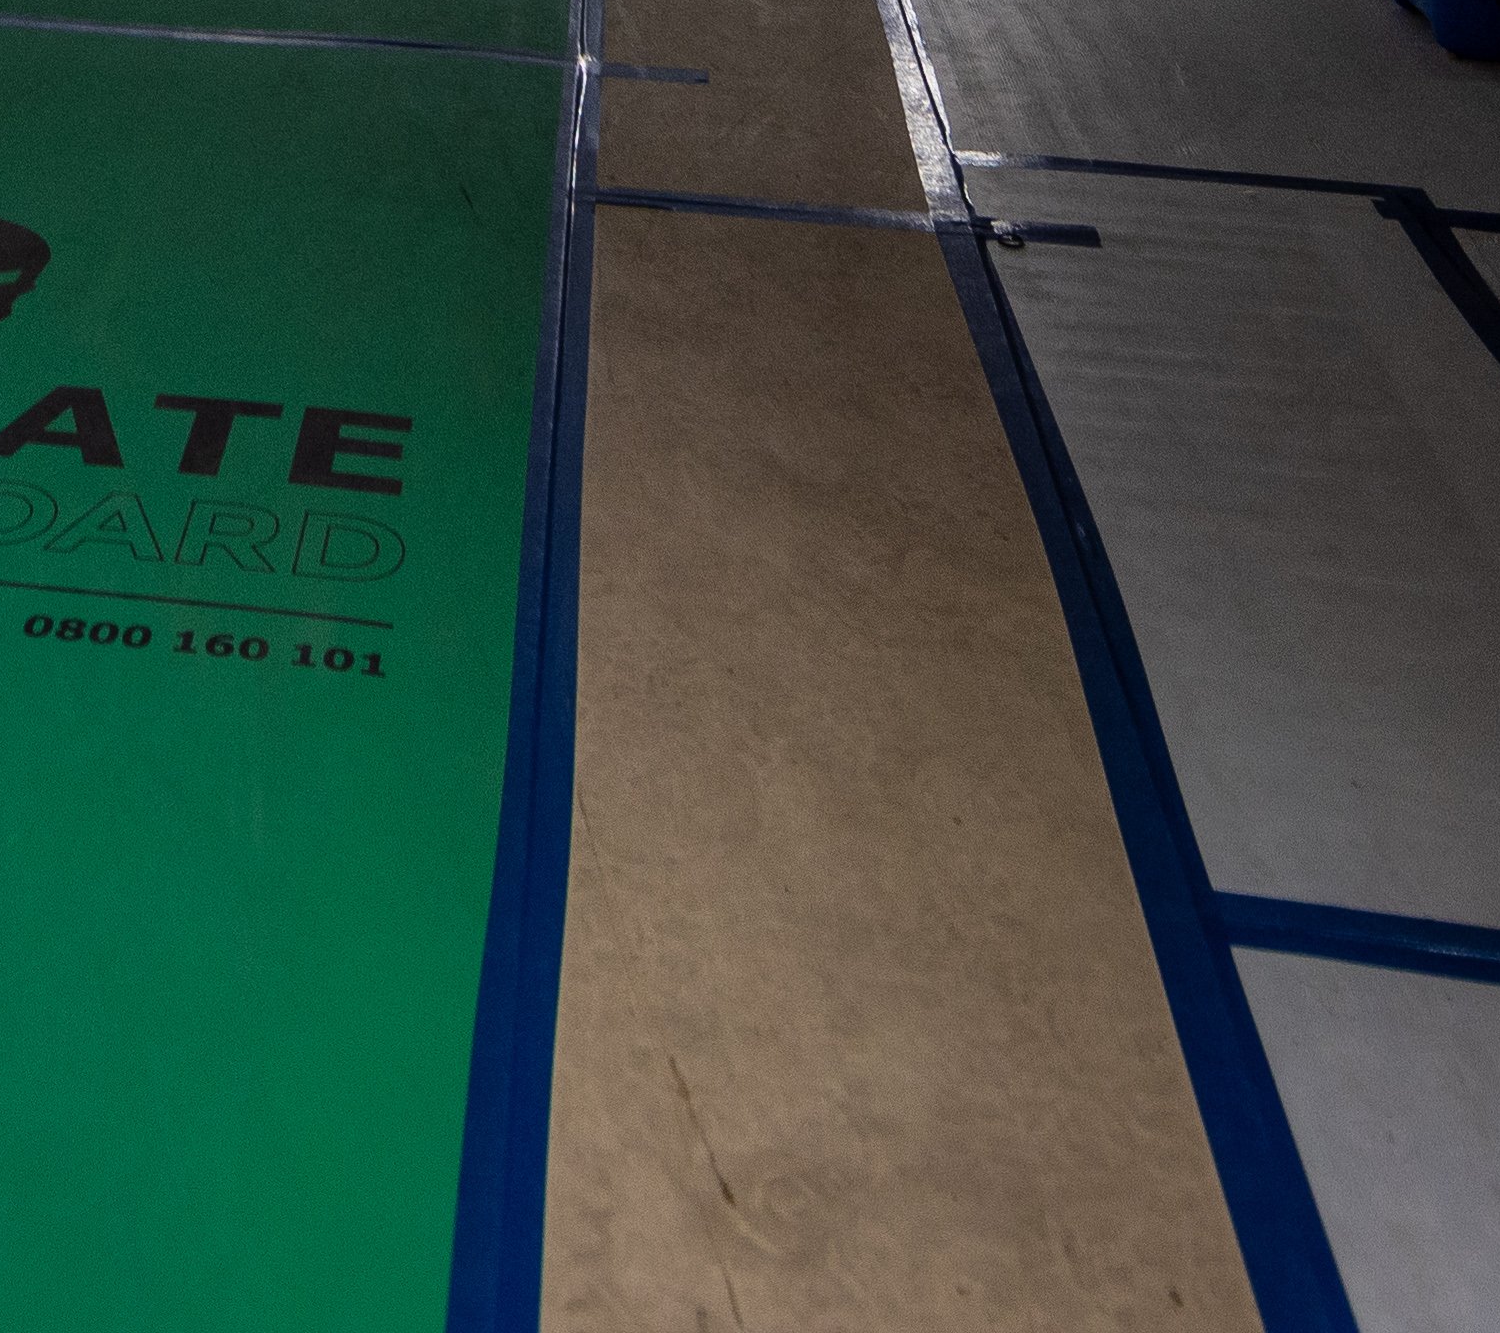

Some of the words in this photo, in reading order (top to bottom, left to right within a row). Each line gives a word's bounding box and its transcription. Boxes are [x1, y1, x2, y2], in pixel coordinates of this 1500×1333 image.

[22, 611, 153, 650] 0800
[172, 626, 272, 664] 160
[289, 642, 389, 678] 101
